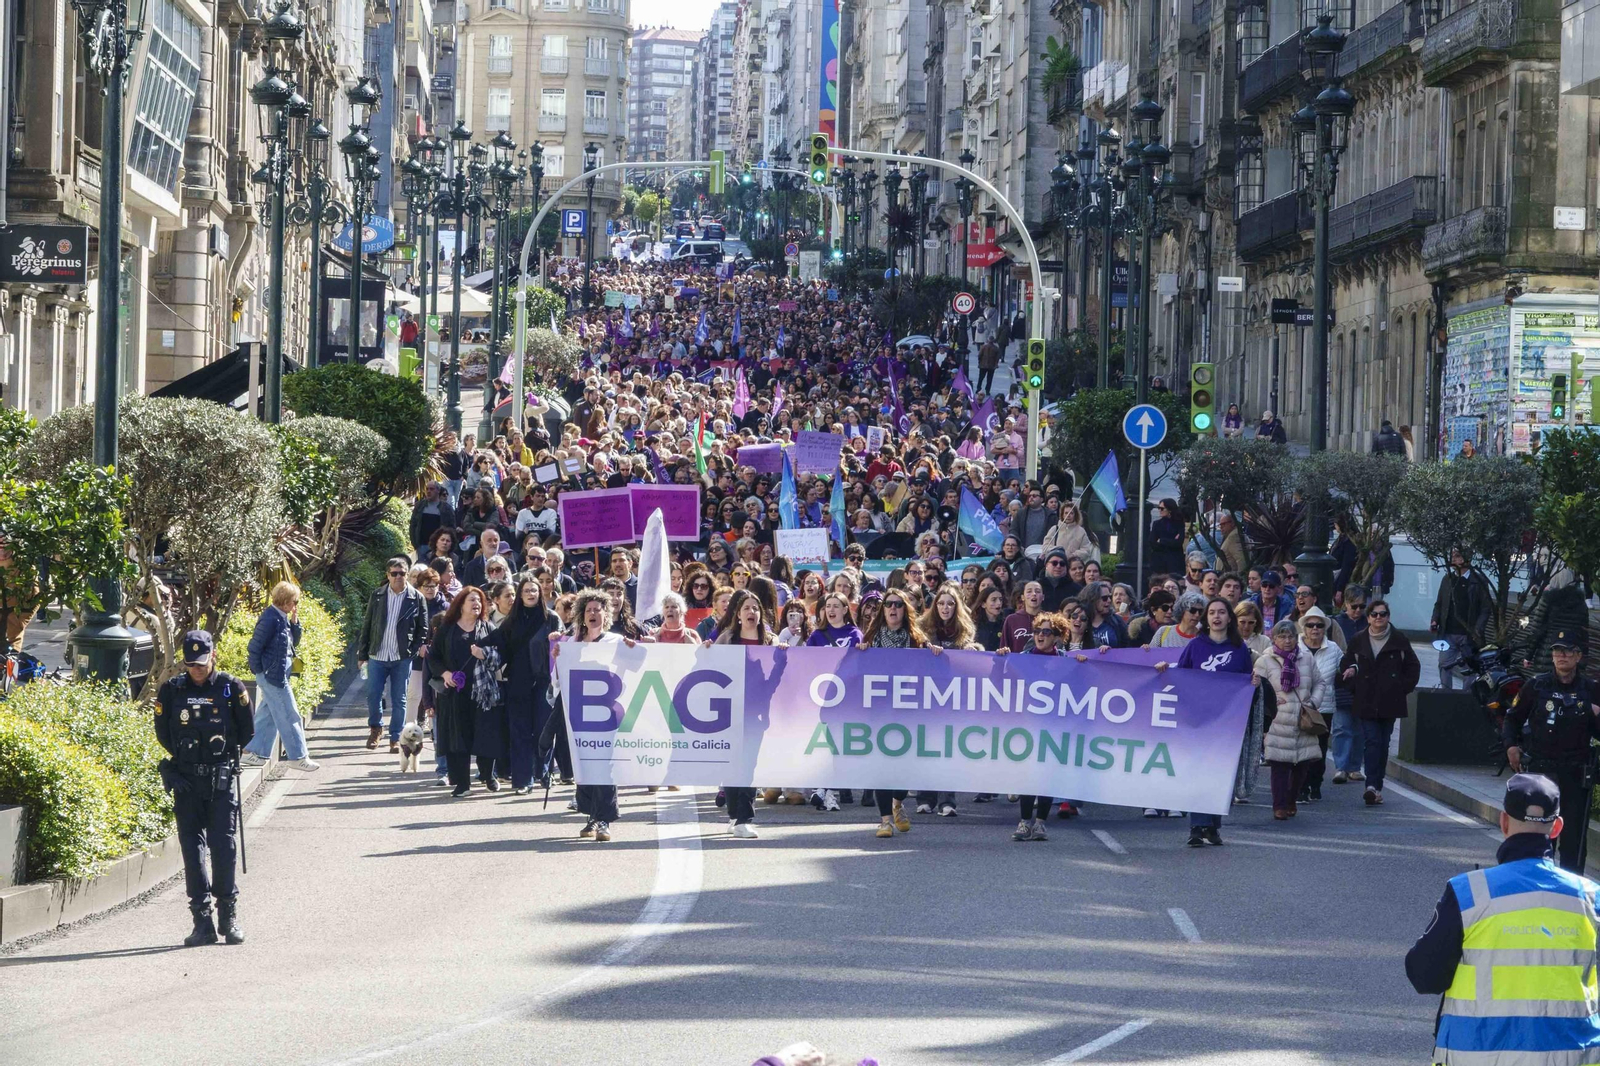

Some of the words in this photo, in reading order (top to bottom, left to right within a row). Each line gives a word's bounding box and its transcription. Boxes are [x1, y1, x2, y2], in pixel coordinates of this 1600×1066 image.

[568, 213, 580, 226] P
[364, 239, 391, 251] DERBY
[11, 255, 82, 269] Peregrinus
[958, 298, 970, 307] 40
[569, 669, 733, 734] BAG
[808, 673, 846, 708] O
[863, 674, 1136, 723] FEMINISMO
[1151, 685, 1179, 728] É
[614, 739, 689, 749] Abolicionista
[692, 740, 731, 750] Galicia
[804, 722, 1176, 777] ABOLICIONISTA
[636, 755, 663, 767] Vigo
